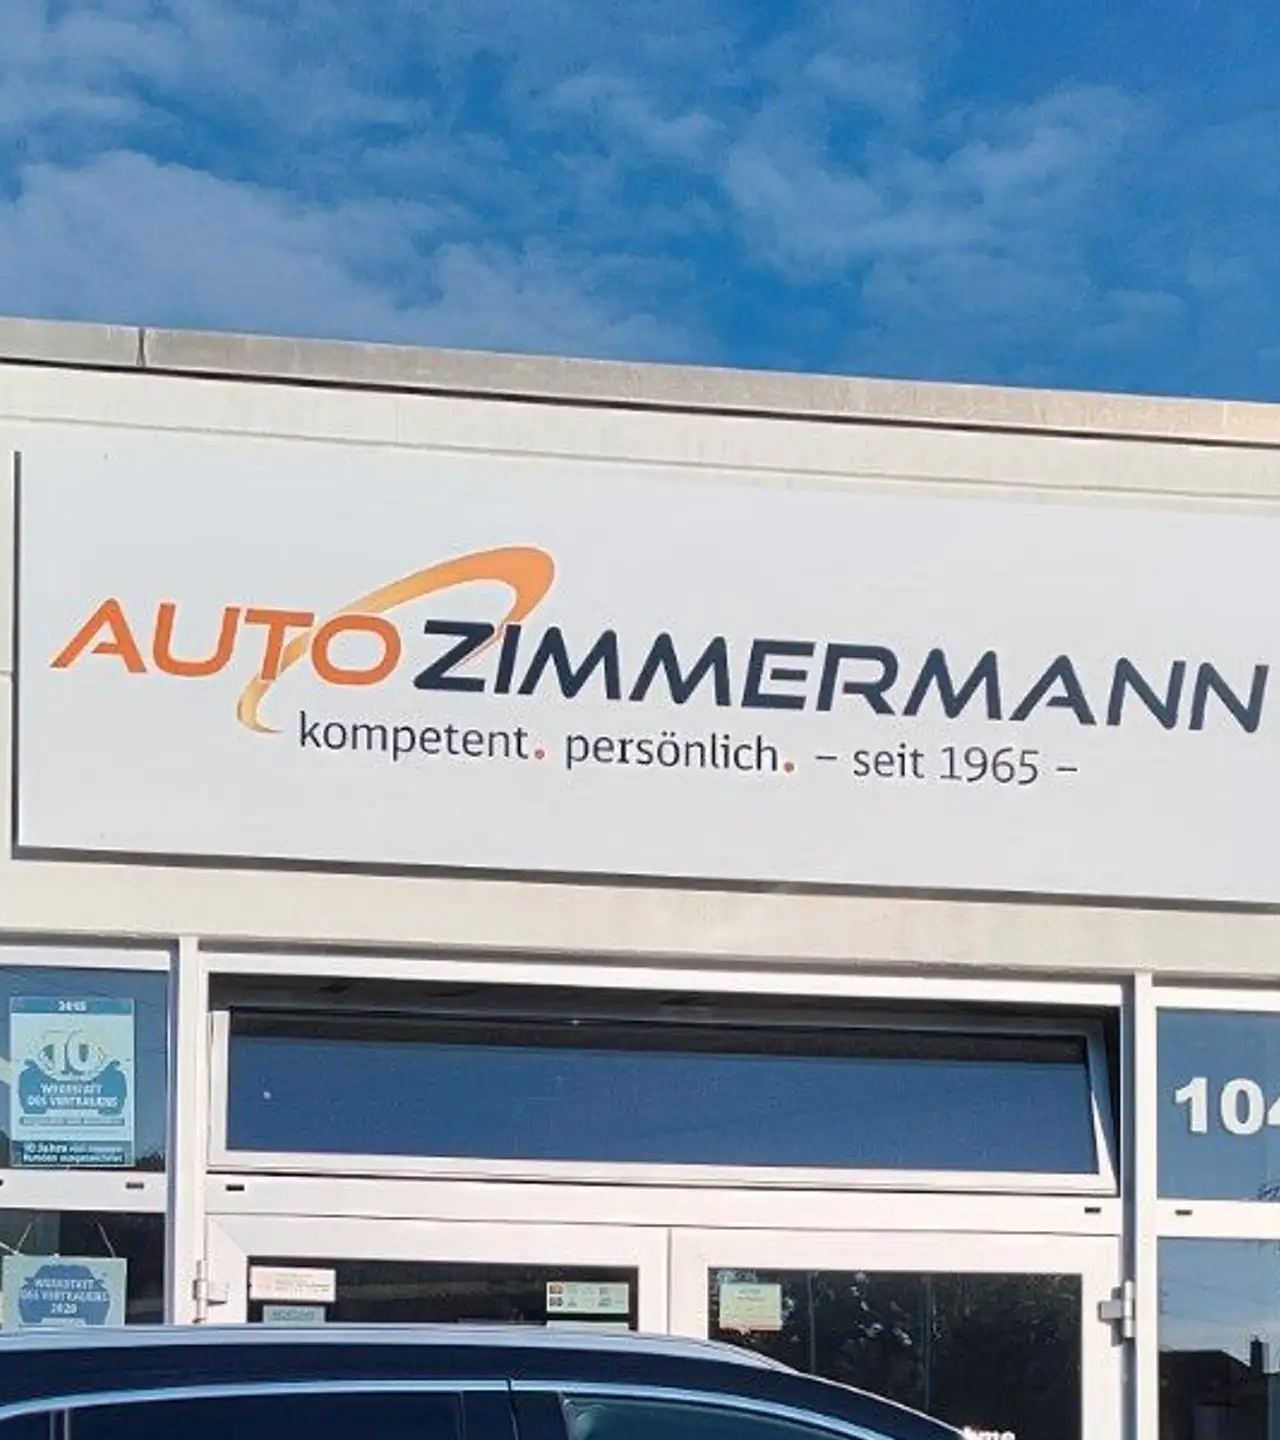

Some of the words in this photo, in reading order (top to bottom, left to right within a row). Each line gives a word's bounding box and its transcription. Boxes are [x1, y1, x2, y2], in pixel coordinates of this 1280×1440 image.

[50, 597, 402, 688] AUTO
[412, 618, 1271, 736] ZIMMERMANN
[298, 711, 547, 765] kompetent.
[563, 727, 797, 780] persönlich.
[851, 738, 926, 782] seit
[940, 741, 1041, 787] 1965
